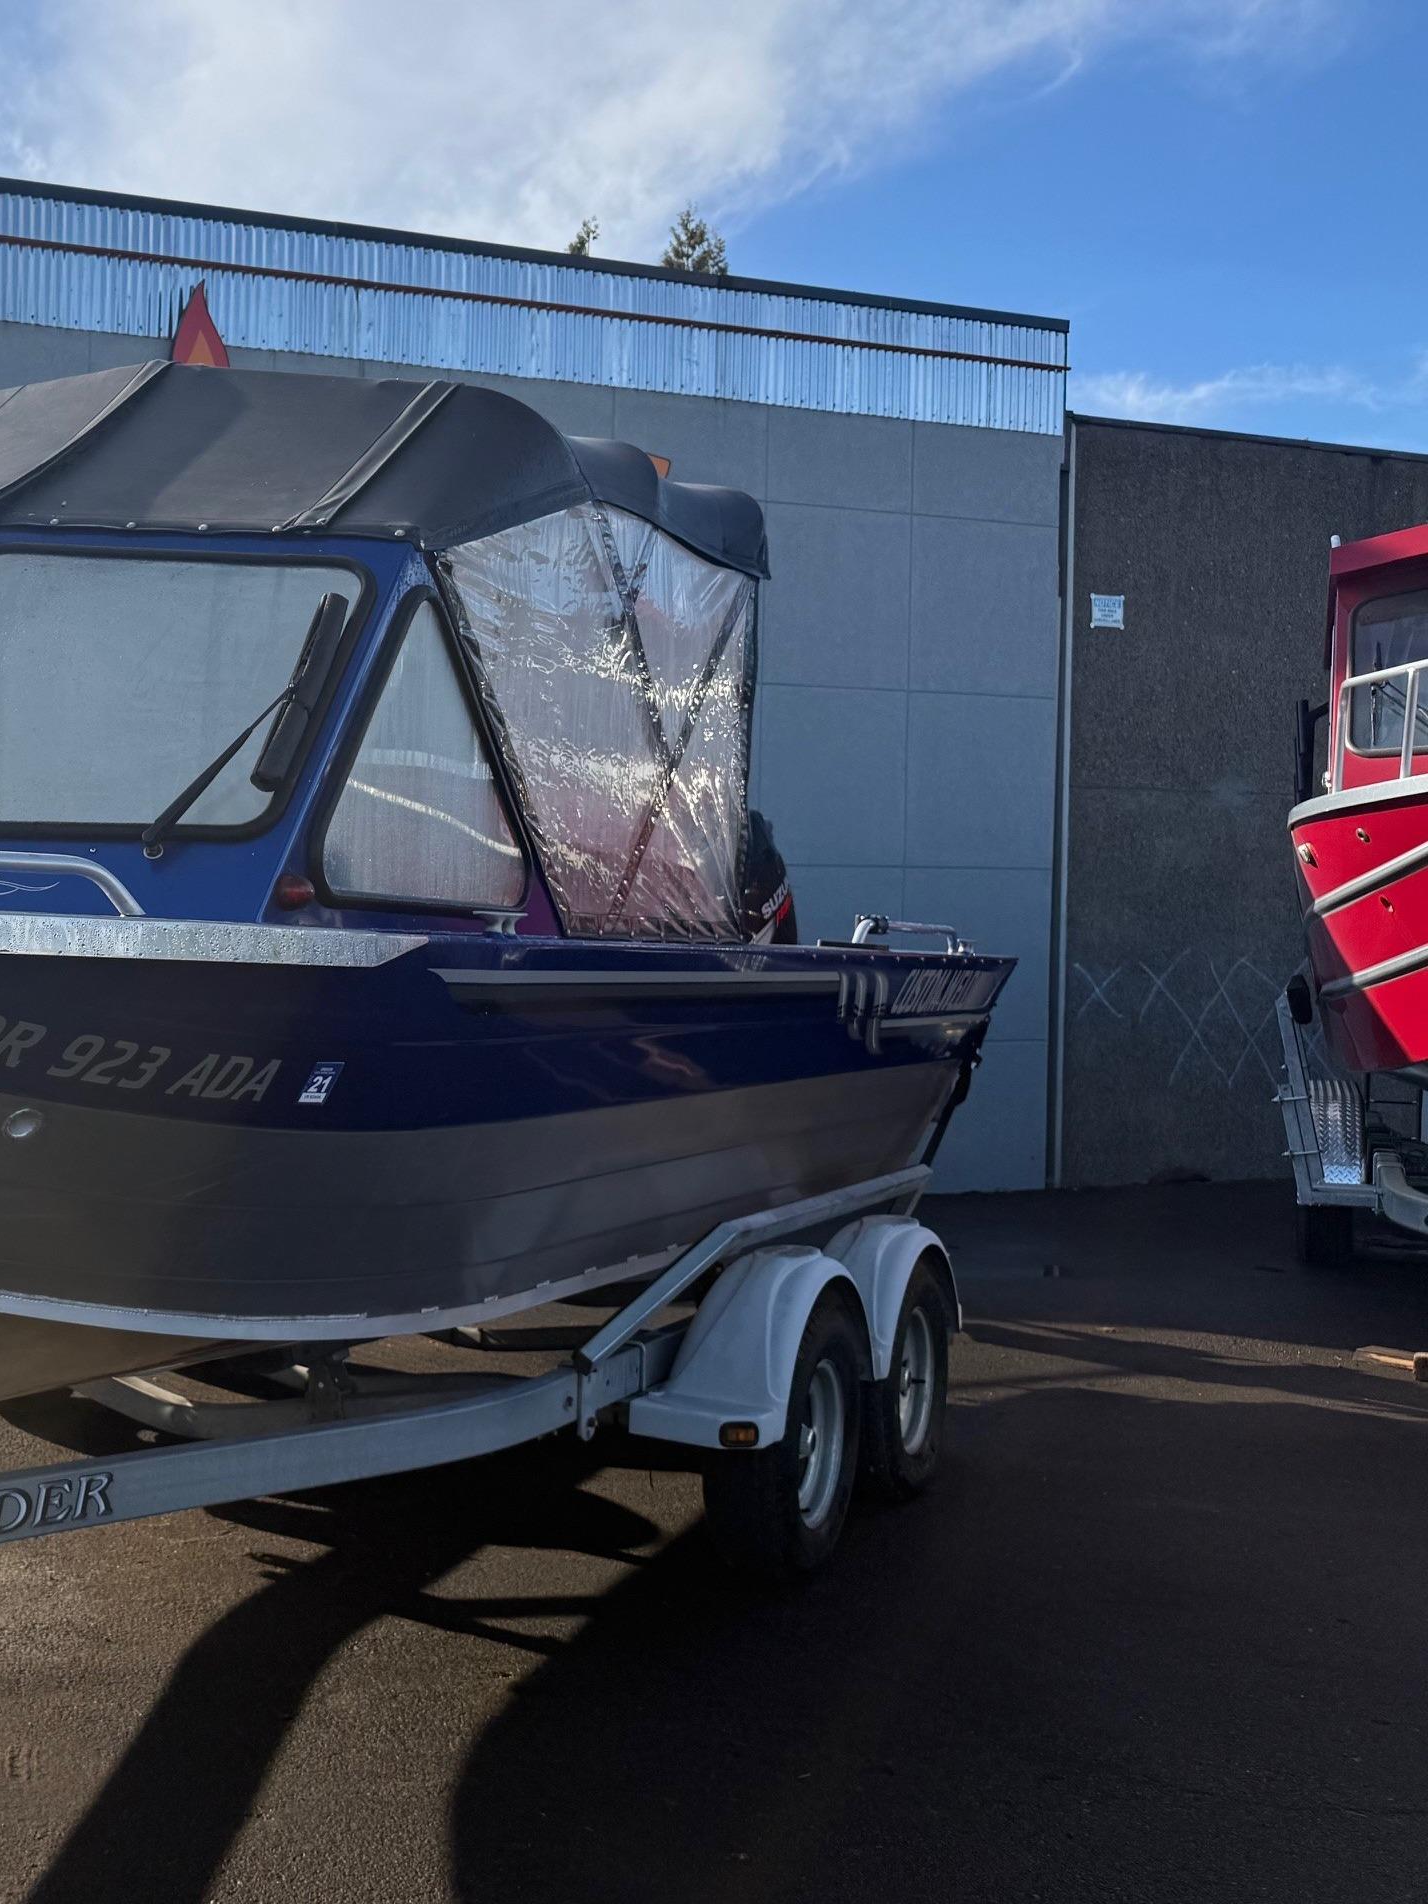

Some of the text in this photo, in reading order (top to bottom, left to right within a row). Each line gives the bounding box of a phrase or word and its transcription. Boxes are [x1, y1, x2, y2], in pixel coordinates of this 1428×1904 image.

[46, 1034, 172, 1090] 923
[165, 1053, 282, 1102] ADA
[307, 1075, 333, 1093] 21
